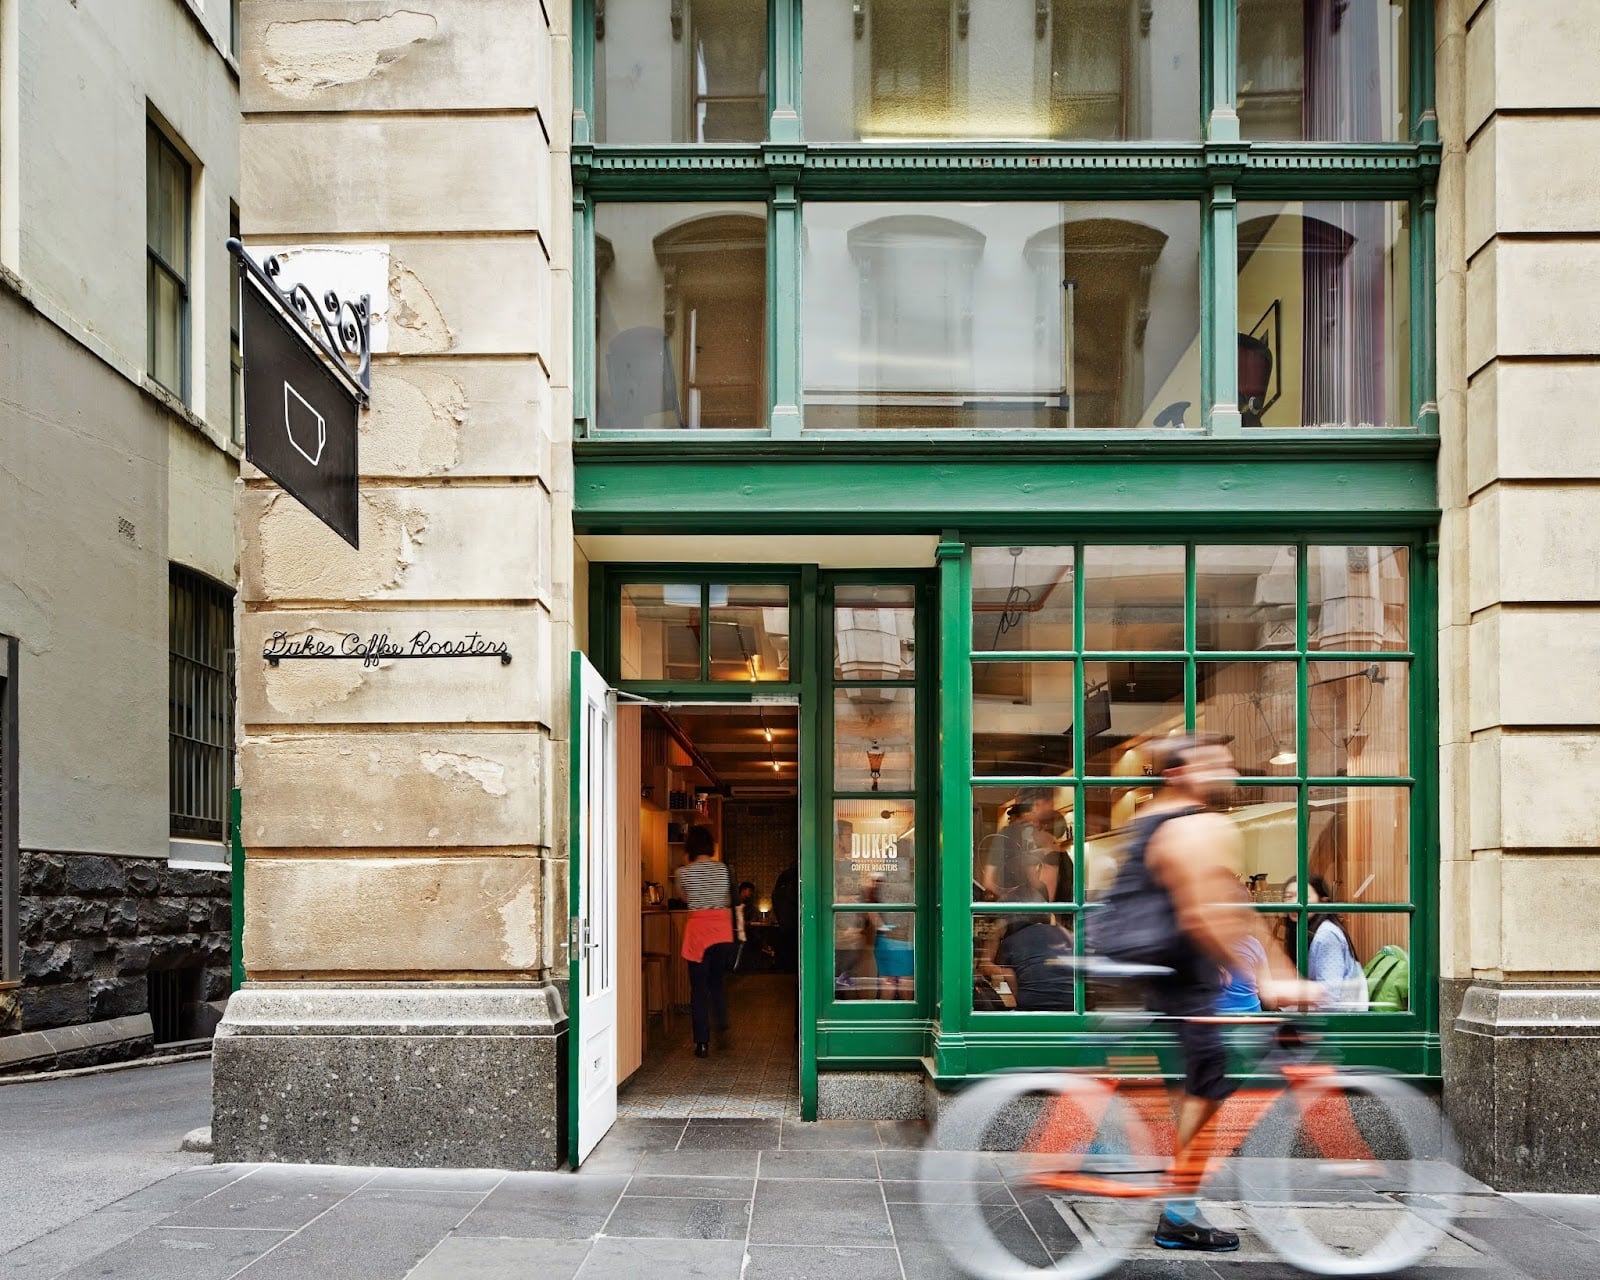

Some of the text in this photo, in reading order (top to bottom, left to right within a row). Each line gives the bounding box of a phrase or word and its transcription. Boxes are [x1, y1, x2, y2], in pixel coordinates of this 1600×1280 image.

[263, 630, 507, 668] Dukes Coffee Roasters
[852, 833, 897, 858] DUKES
[852, 864, 897, 872] COFFEE ROASTERS
